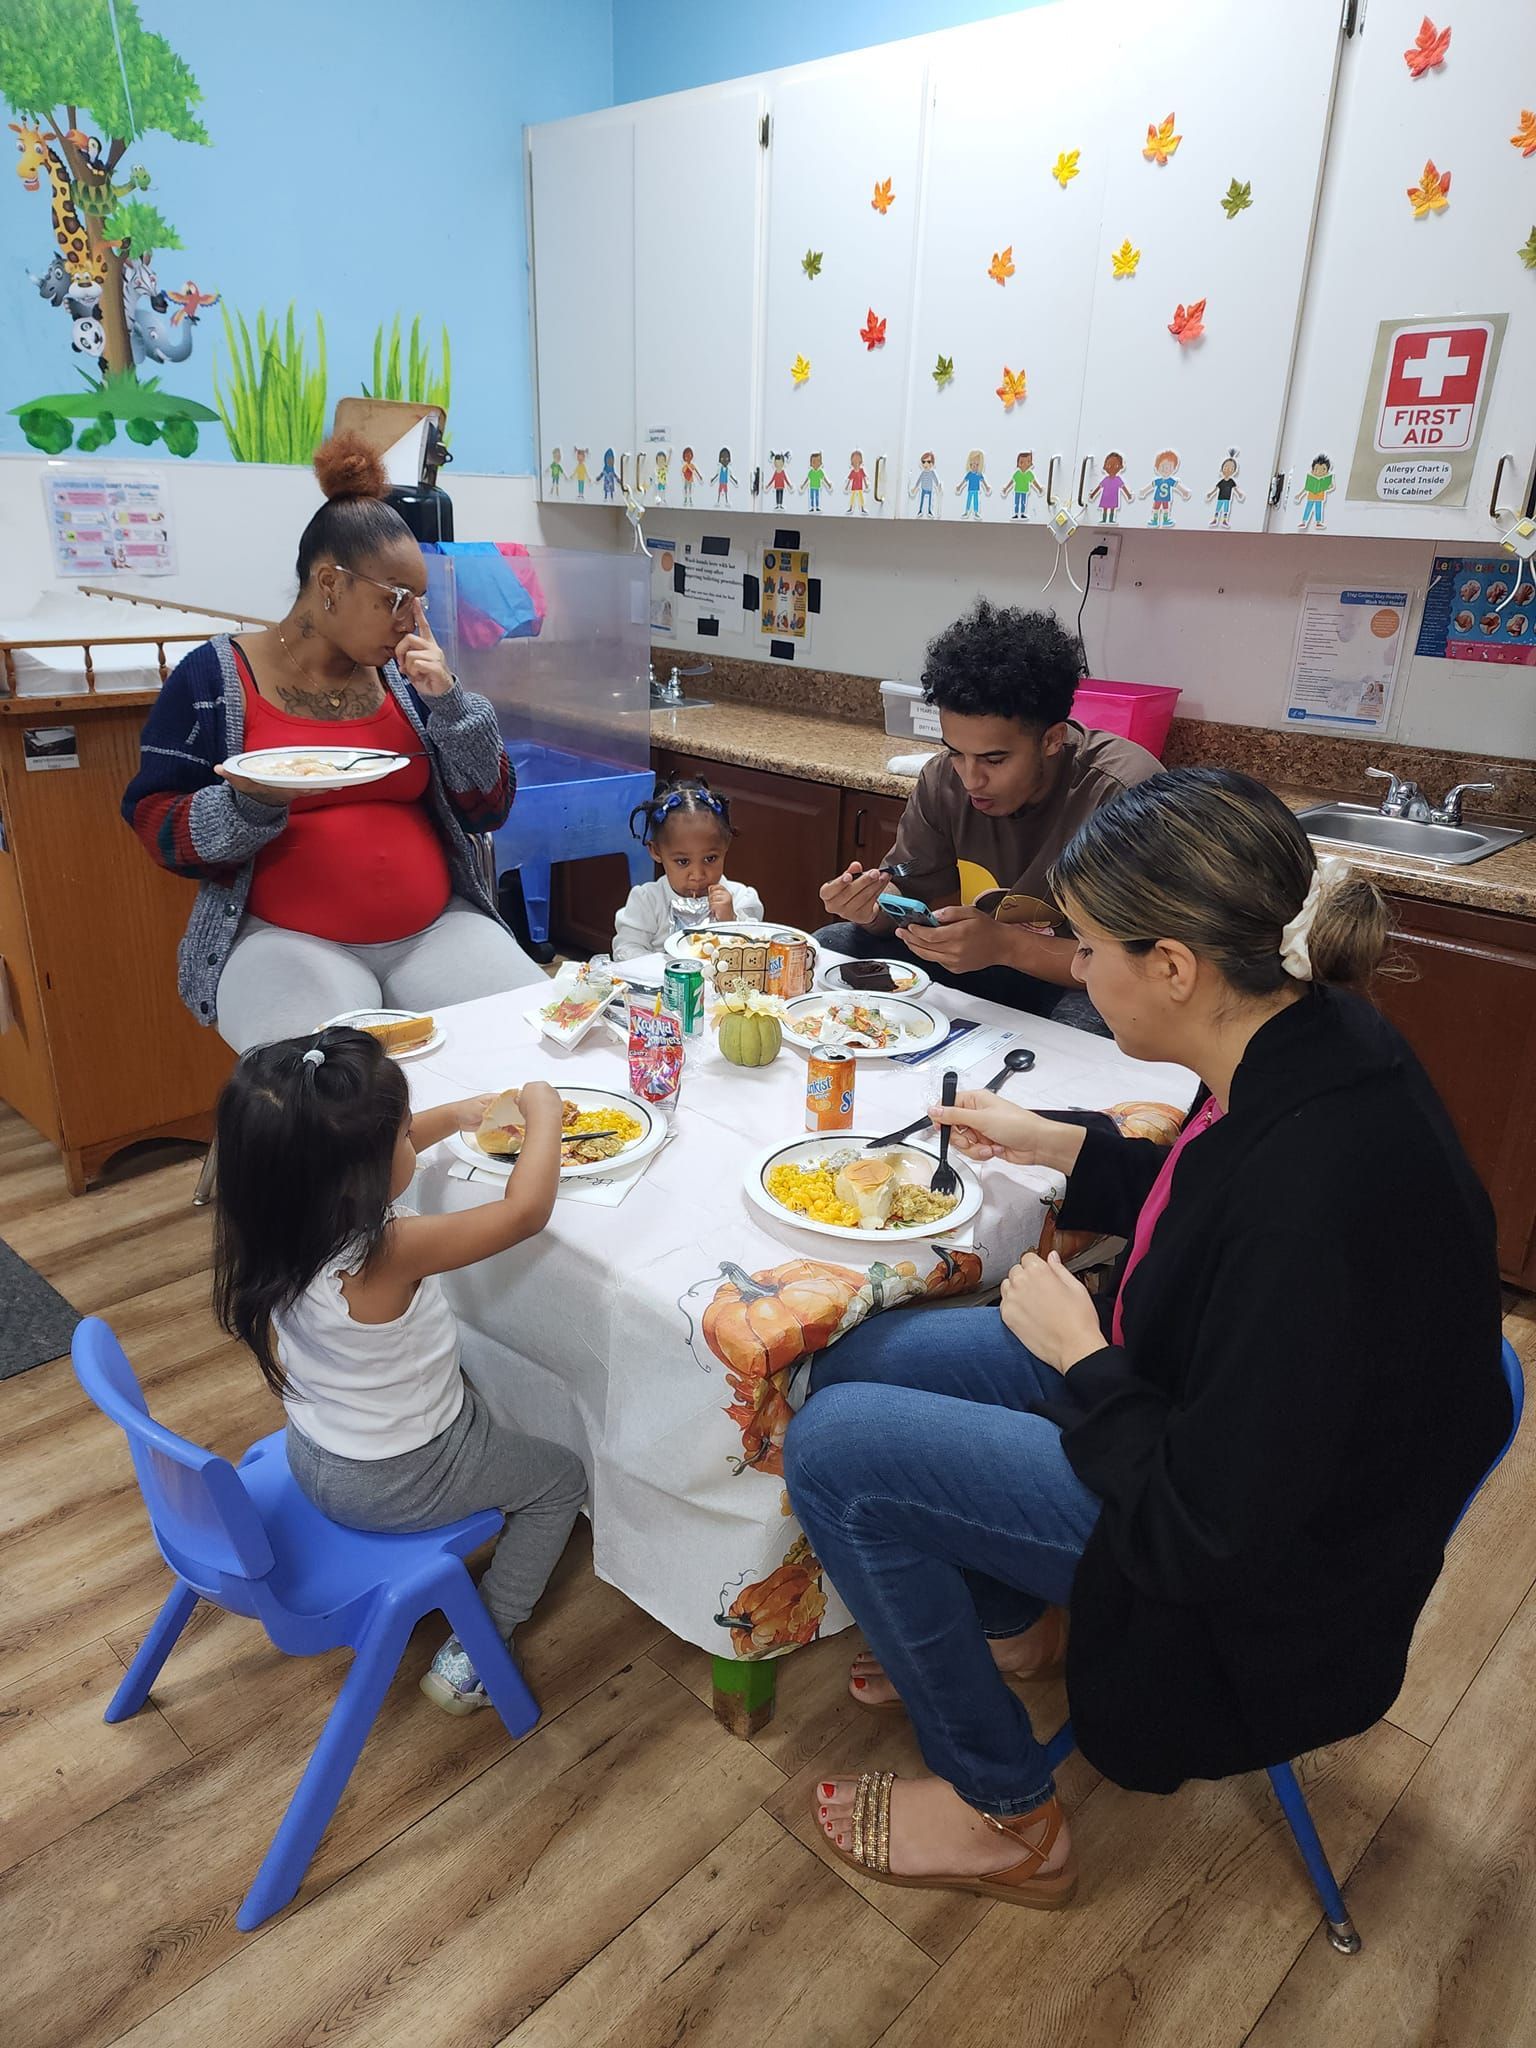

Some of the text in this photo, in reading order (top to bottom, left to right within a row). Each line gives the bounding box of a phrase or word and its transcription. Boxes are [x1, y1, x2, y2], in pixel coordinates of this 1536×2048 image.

[1394, 408, 1461, 426] FIRST
[1402, 428, 1444, 445] AID
[1385, 465, 1449, 474] Allergy Chart is
[1384, 476, 1445, 484] Located Inside
[1159, 483, 1169, 498] S
[1382, 487, 1433, 496] This Cabinet
[632, 1015, 673, 1037] Kool-Aid
